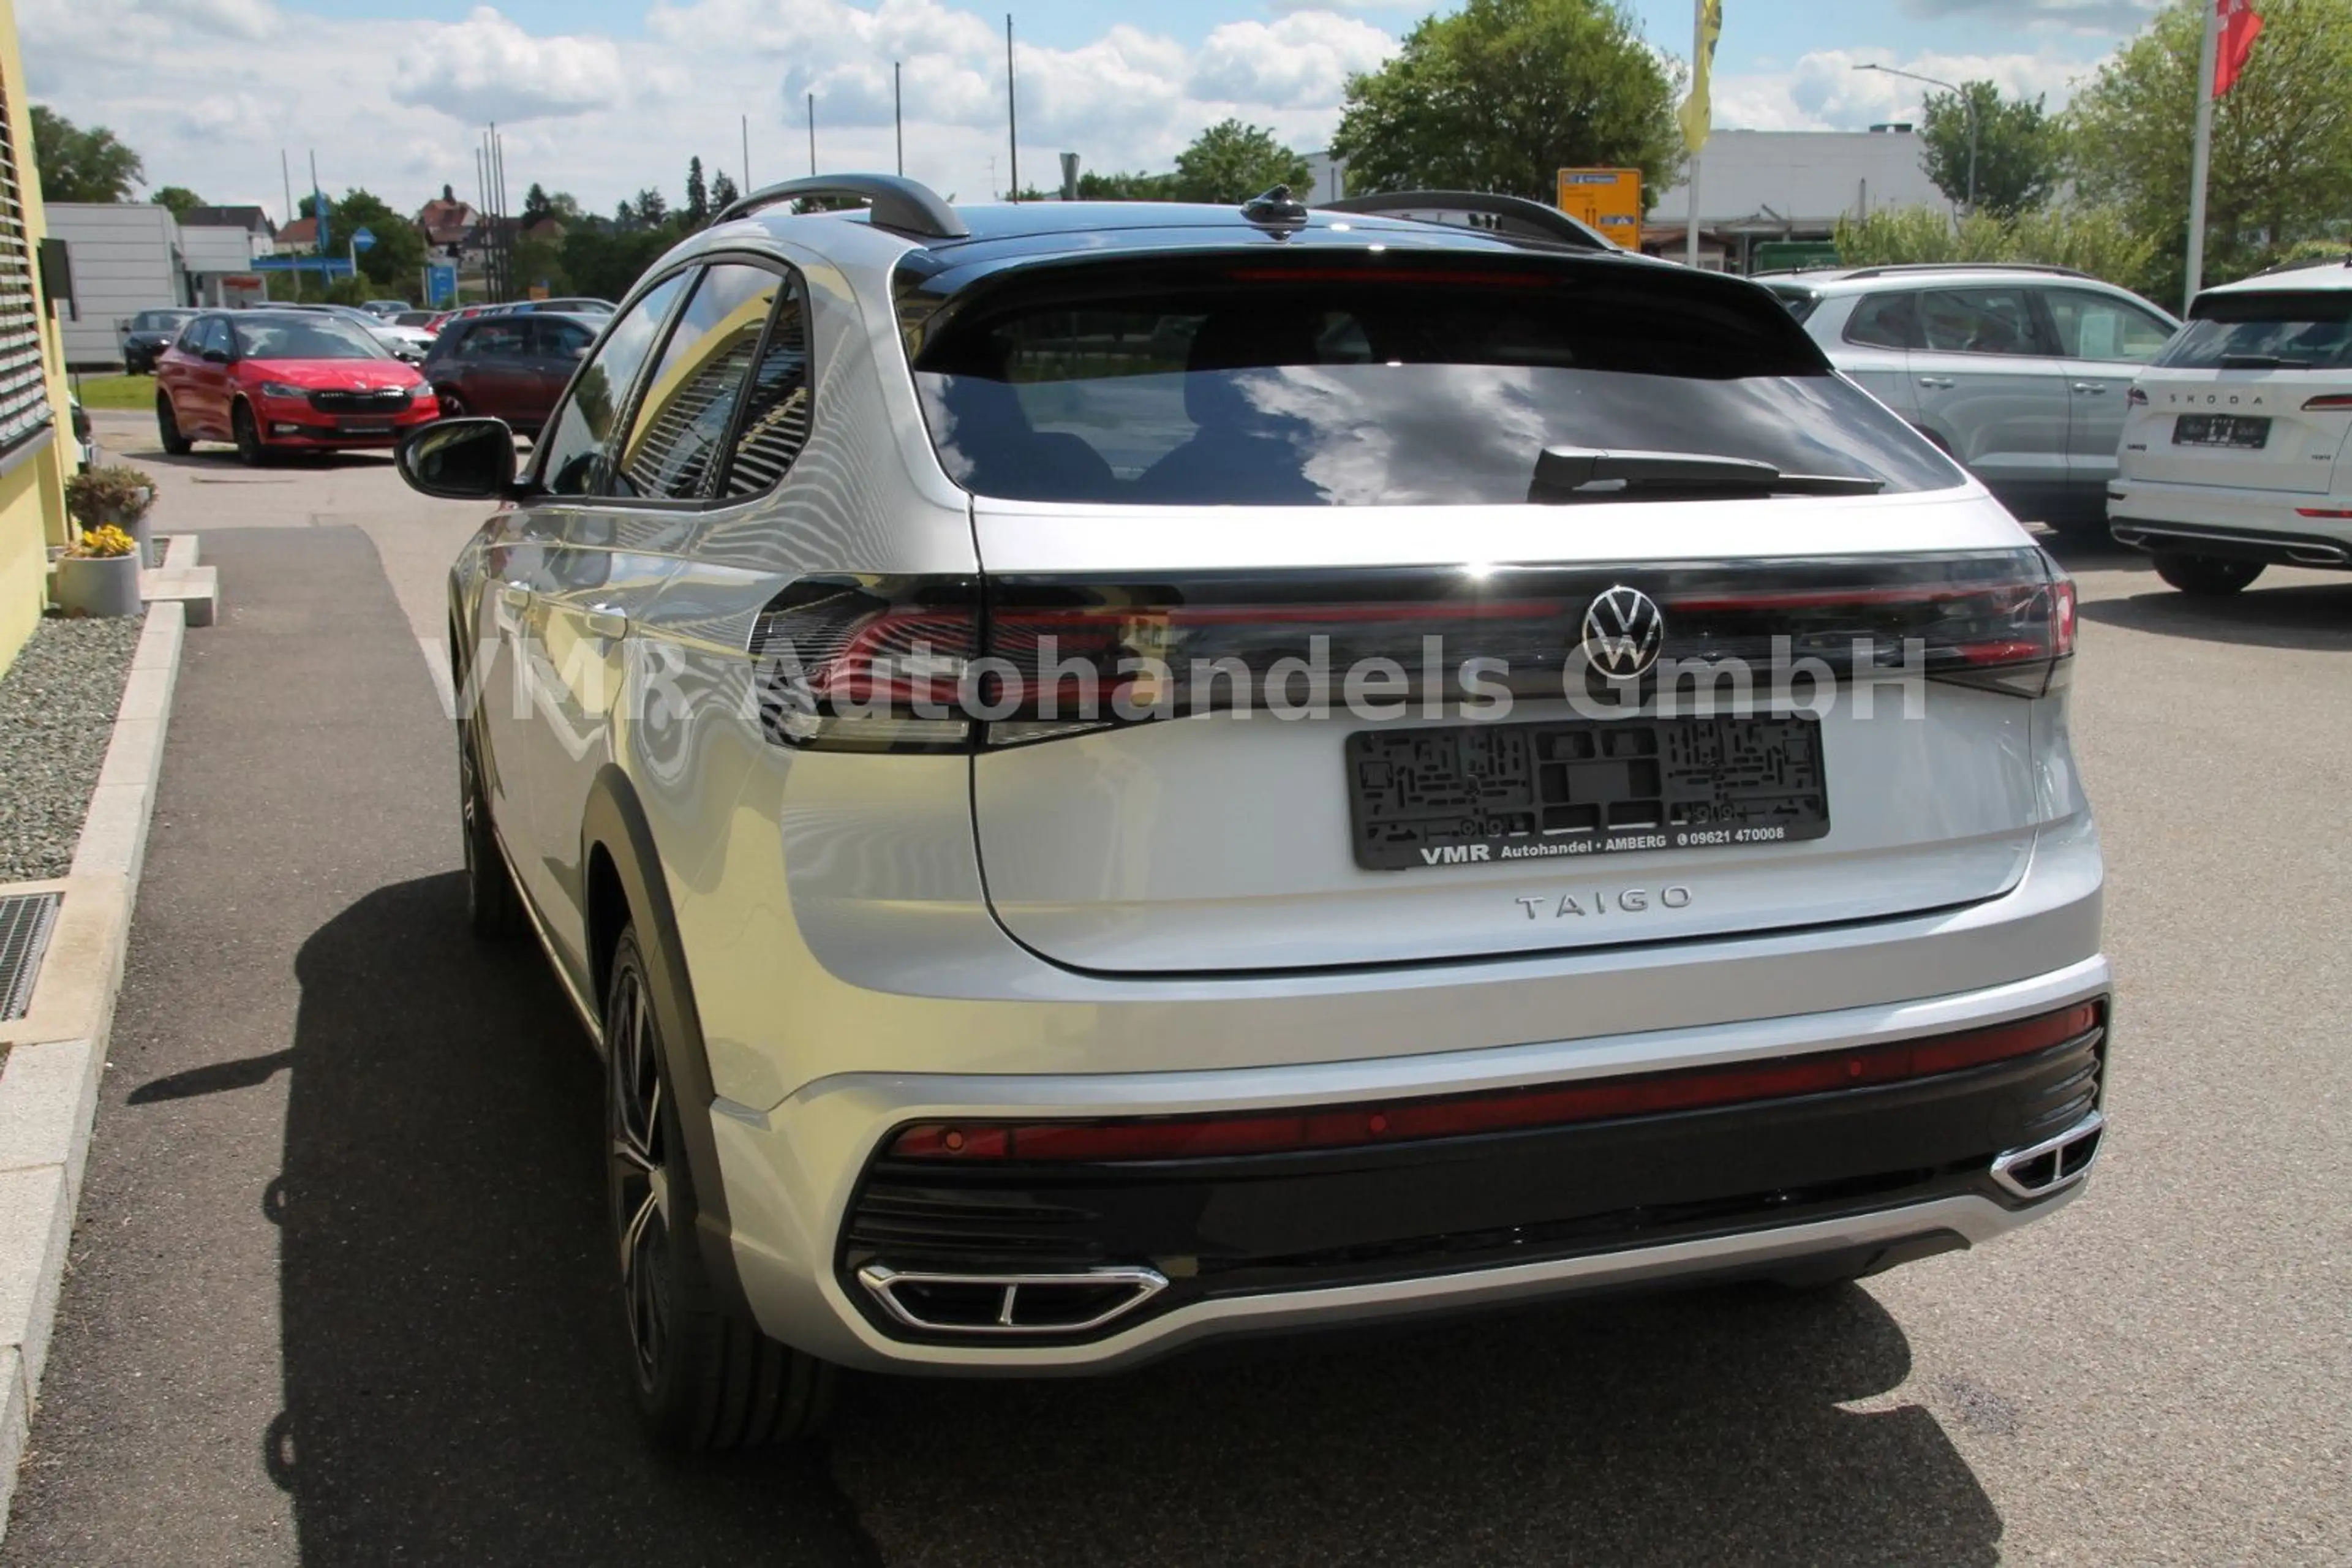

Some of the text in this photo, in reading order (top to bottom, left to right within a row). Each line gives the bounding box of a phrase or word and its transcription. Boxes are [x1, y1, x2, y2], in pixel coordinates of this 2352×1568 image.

[1420, 827, 1785, 865] VMR Autohandel AMBERG 09621 470008
[1515, 886, 1691, 919] TAIGO
